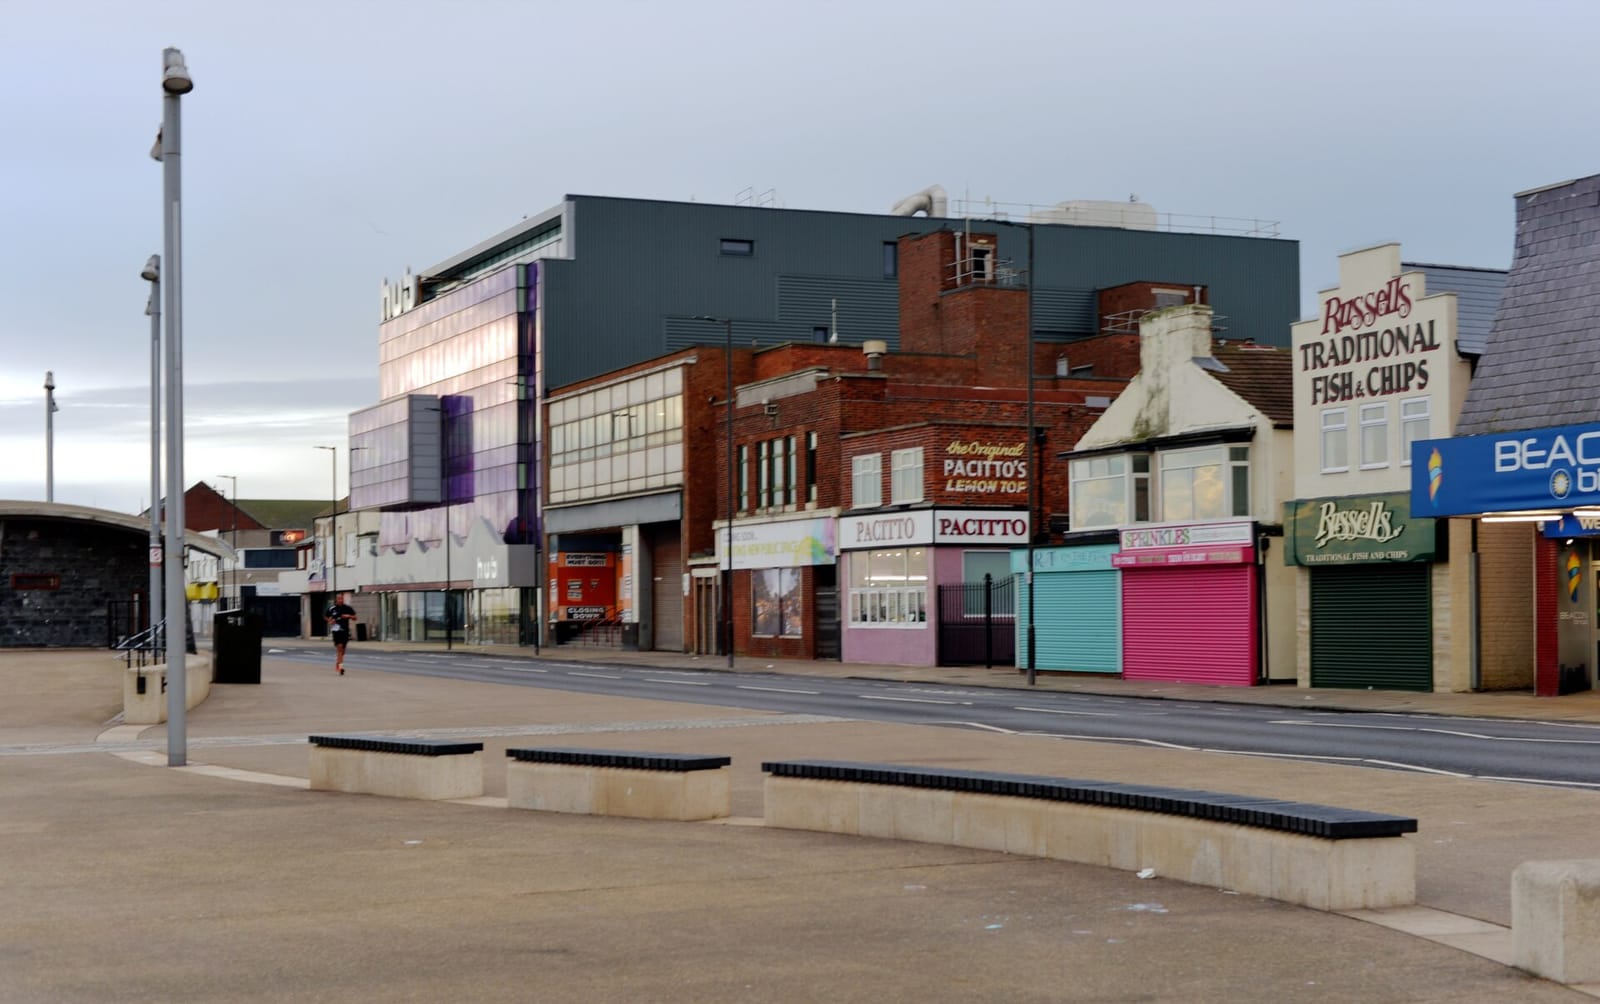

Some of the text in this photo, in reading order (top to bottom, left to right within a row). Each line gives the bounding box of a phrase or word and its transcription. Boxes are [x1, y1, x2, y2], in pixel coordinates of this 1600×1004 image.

[1321, 277, 1411, 335] Russells
[1300, 319, 1440, 372] TRADITIONAL
[1311, 359, 1429, 405] FISH & CHIPS
[945, 441, 1026, 461] the Original
[1495, 431, 1600, 472] BEAC
[944, 460, 1027, 478] PACITTO'S
[945, 479, 998, 493] LEMON
[856, 517, 915, 543] PACITTO
[939, 519, 1027, 536] PACITTO
[1314, 502, 1402, 546] Russells
[1125, 528, 1190, 548] SPRINKLES
[477, 556, 498, 579] hub
[1305, 550, 1408, 562] TRADITIONAL FISH AND CHIPS
